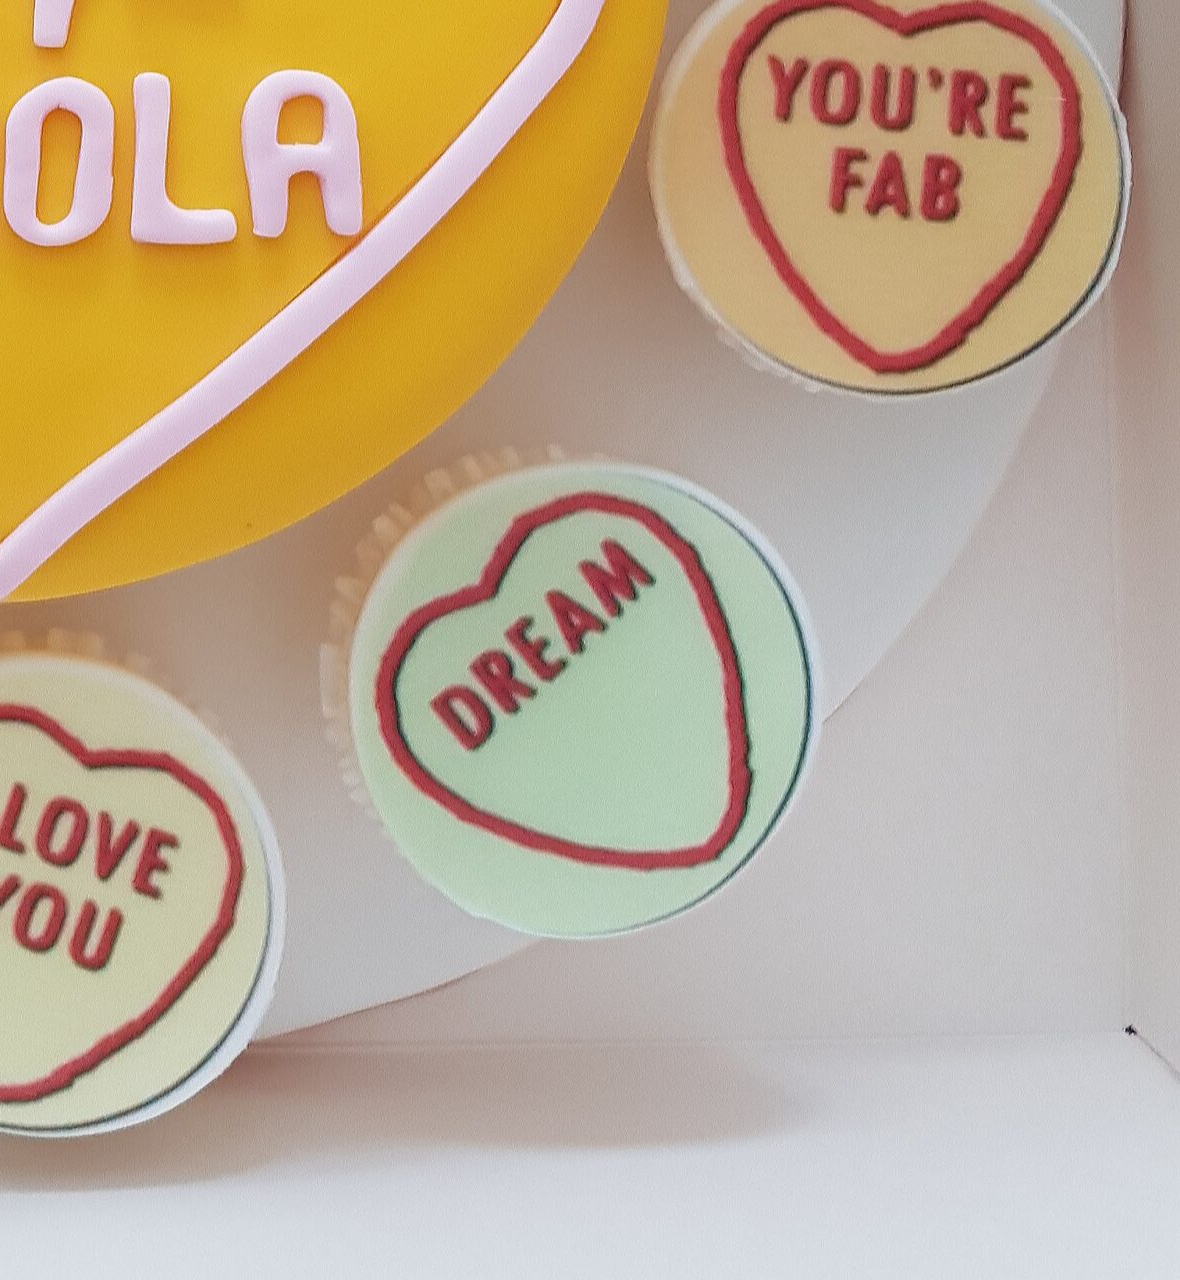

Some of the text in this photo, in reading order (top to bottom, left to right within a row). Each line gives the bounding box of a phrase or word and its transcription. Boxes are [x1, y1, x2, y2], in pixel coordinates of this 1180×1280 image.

[768, 56, 1032, 141] YOU'RE
[830, 148, 964, 223] FAB
[430, 540, 657, 750] DREAM
